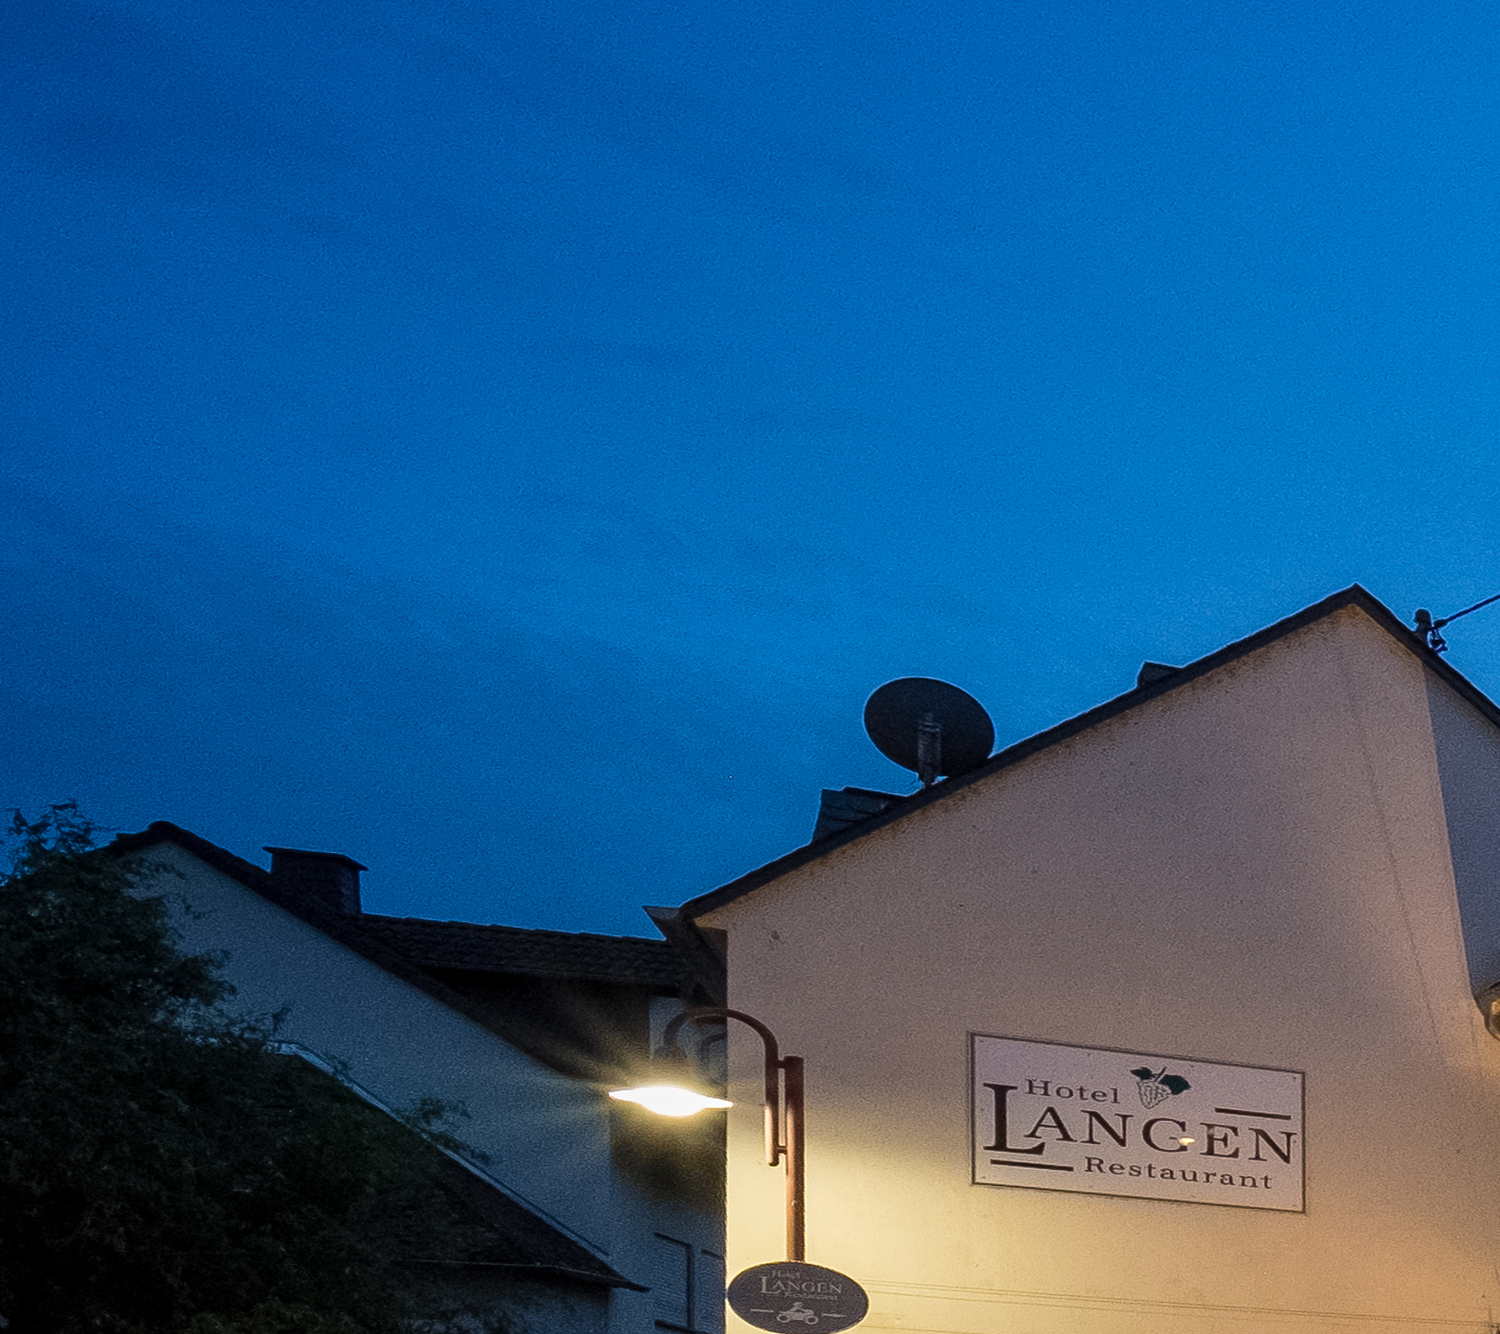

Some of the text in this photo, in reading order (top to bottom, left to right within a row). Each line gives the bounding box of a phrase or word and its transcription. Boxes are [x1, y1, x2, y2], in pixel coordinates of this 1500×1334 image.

[1026, 1078, 1121, 1104] Hotel
[983, 1083, 1297, 1164] LANGEN
[1084, 1156, 1273, 1190] Restaurant
